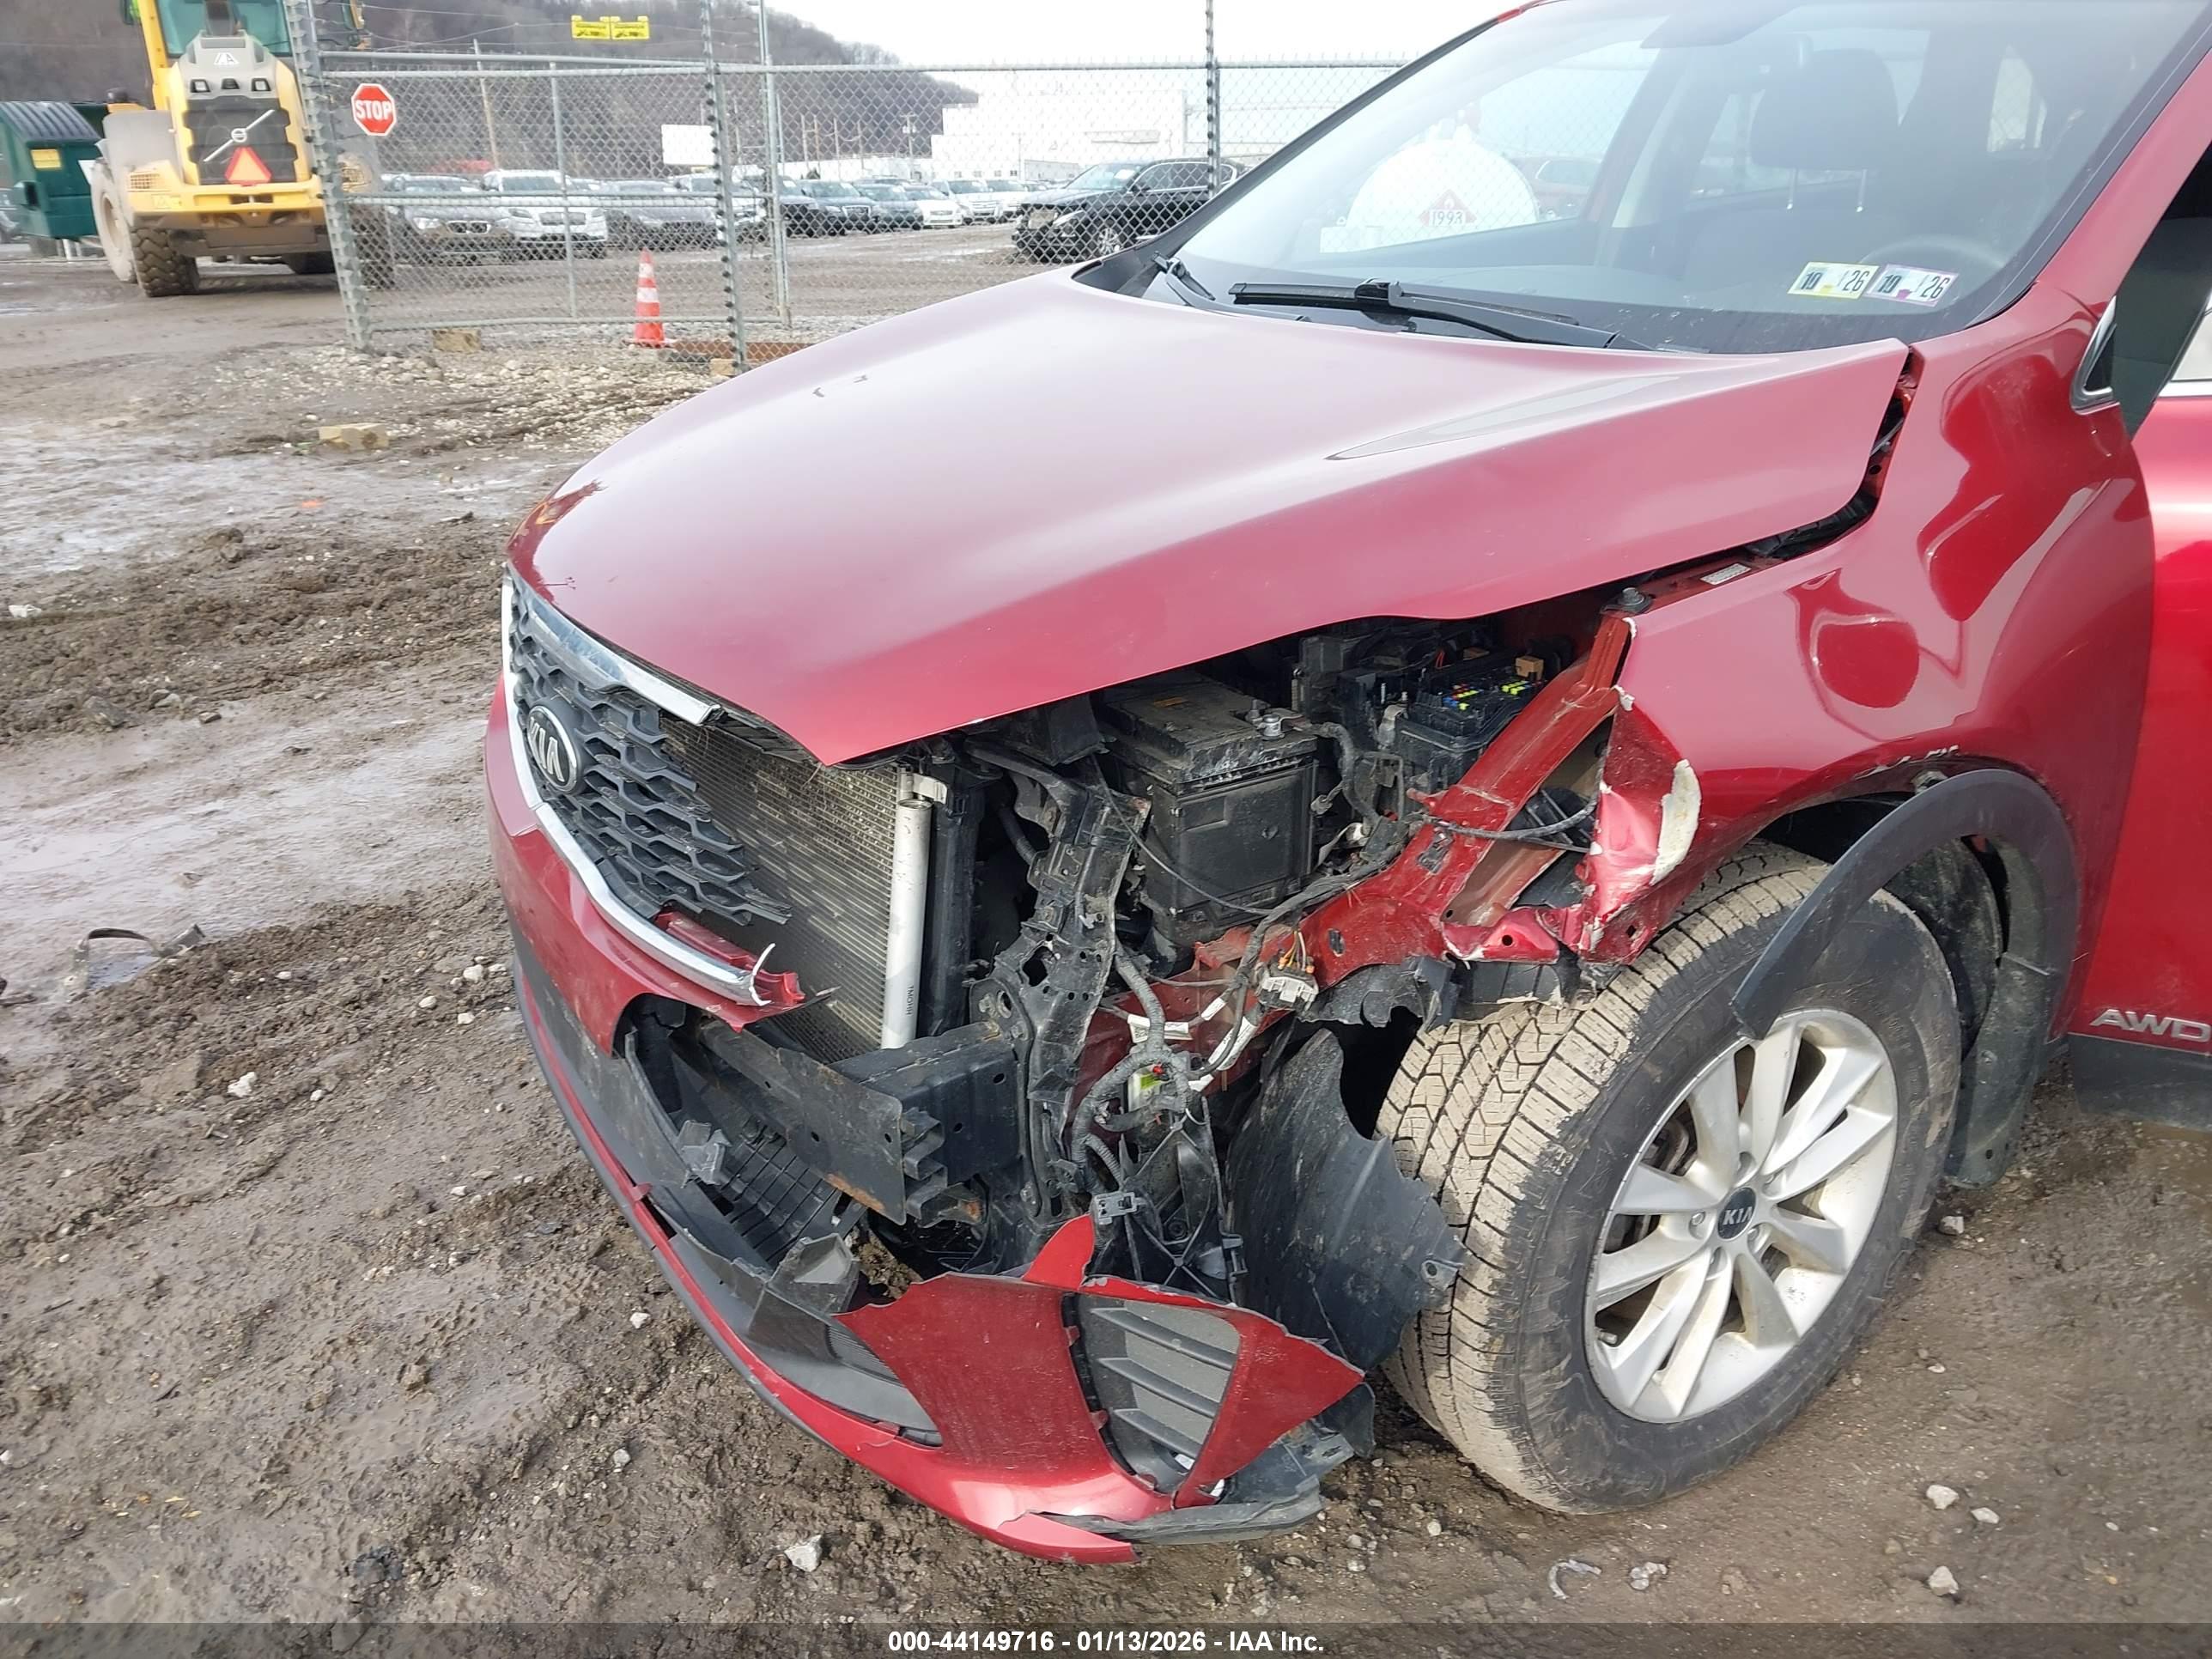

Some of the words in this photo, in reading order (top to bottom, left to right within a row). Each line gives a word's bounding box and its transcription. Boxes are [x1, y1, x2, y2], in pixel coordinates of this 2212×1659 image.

[355, 100, 392, 120] STOP
[1842, 270, 1870, 292] 26
[1920, 275, 1950, 299] 26
[2089, 1008, 2211, 1042] AWD
[1723, 1206, 1753, 1226] KIA
